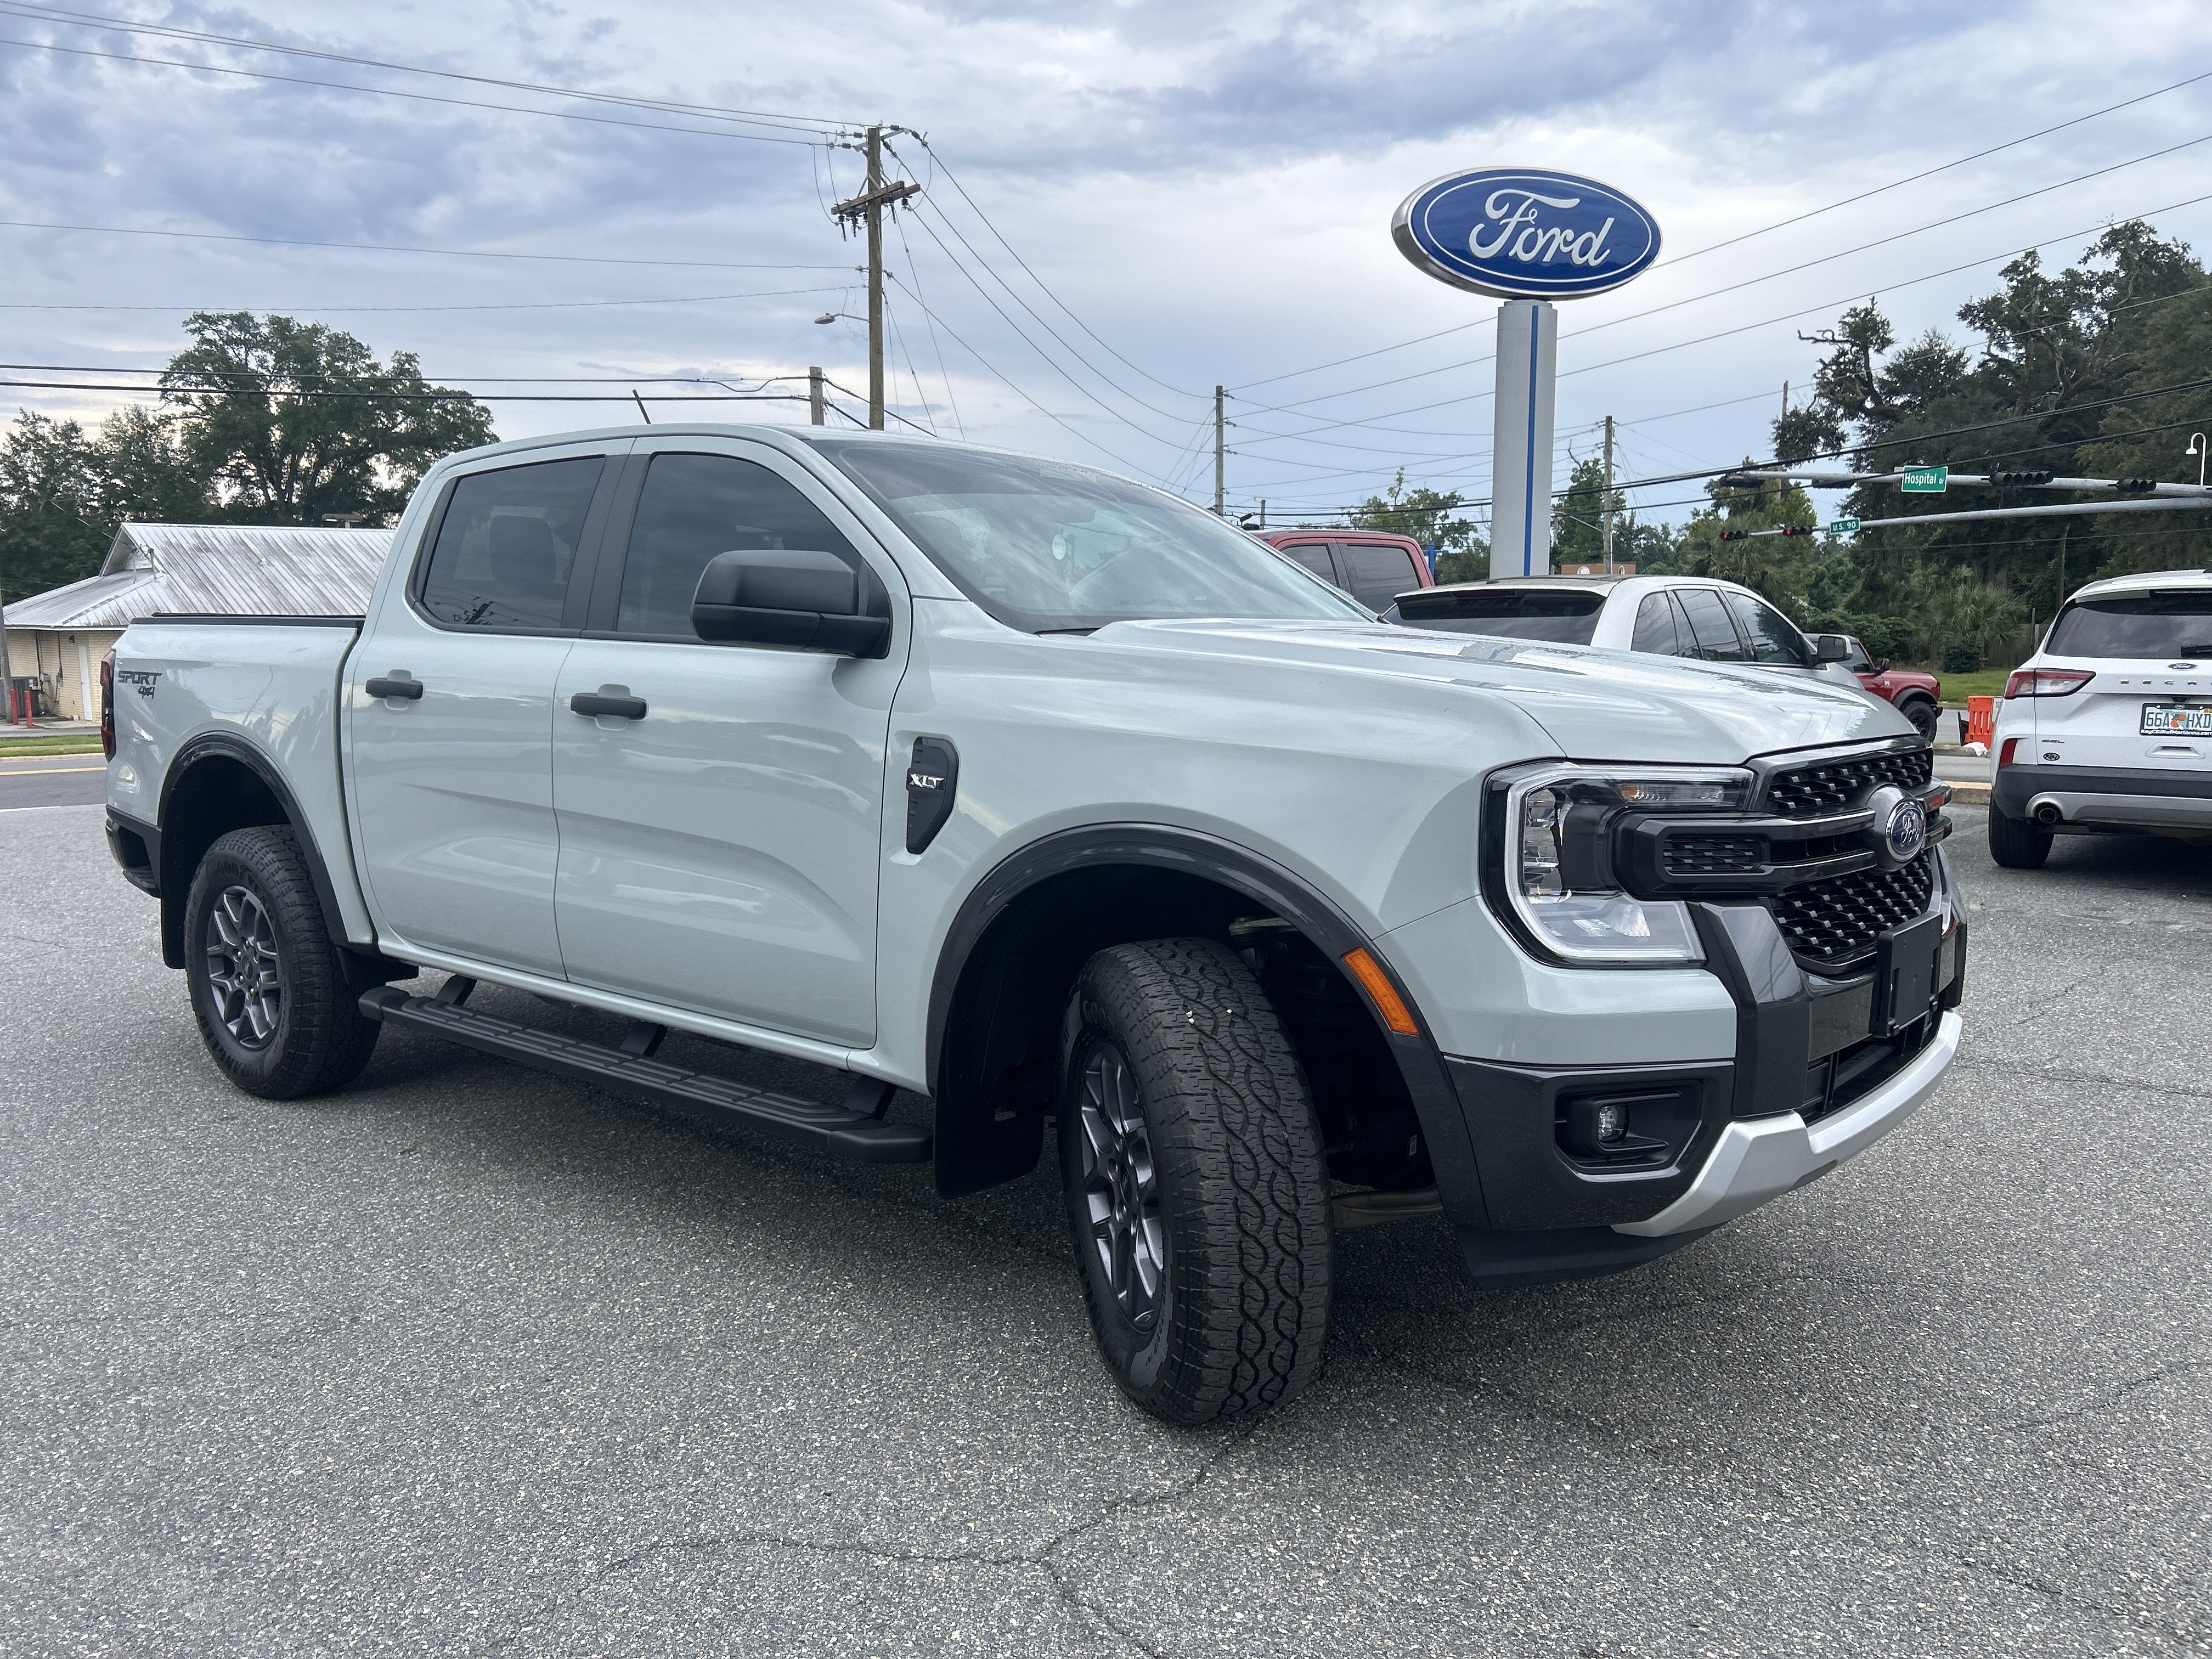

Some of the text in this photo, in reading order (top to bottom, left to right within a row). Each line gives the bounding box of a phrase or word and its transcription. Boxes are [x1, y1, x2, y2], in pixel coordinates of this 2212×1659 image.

[1469, 189, 1615, 267] Ford
[1904, 472, 1937, 487] Hospital
[1832, 521, 1856, 532] U.S. 90
[117, 670, 162, 685] SPORT
[2146, 712, 2211, 728] 66A HXD
[909, 772, 944, 789] XLT
